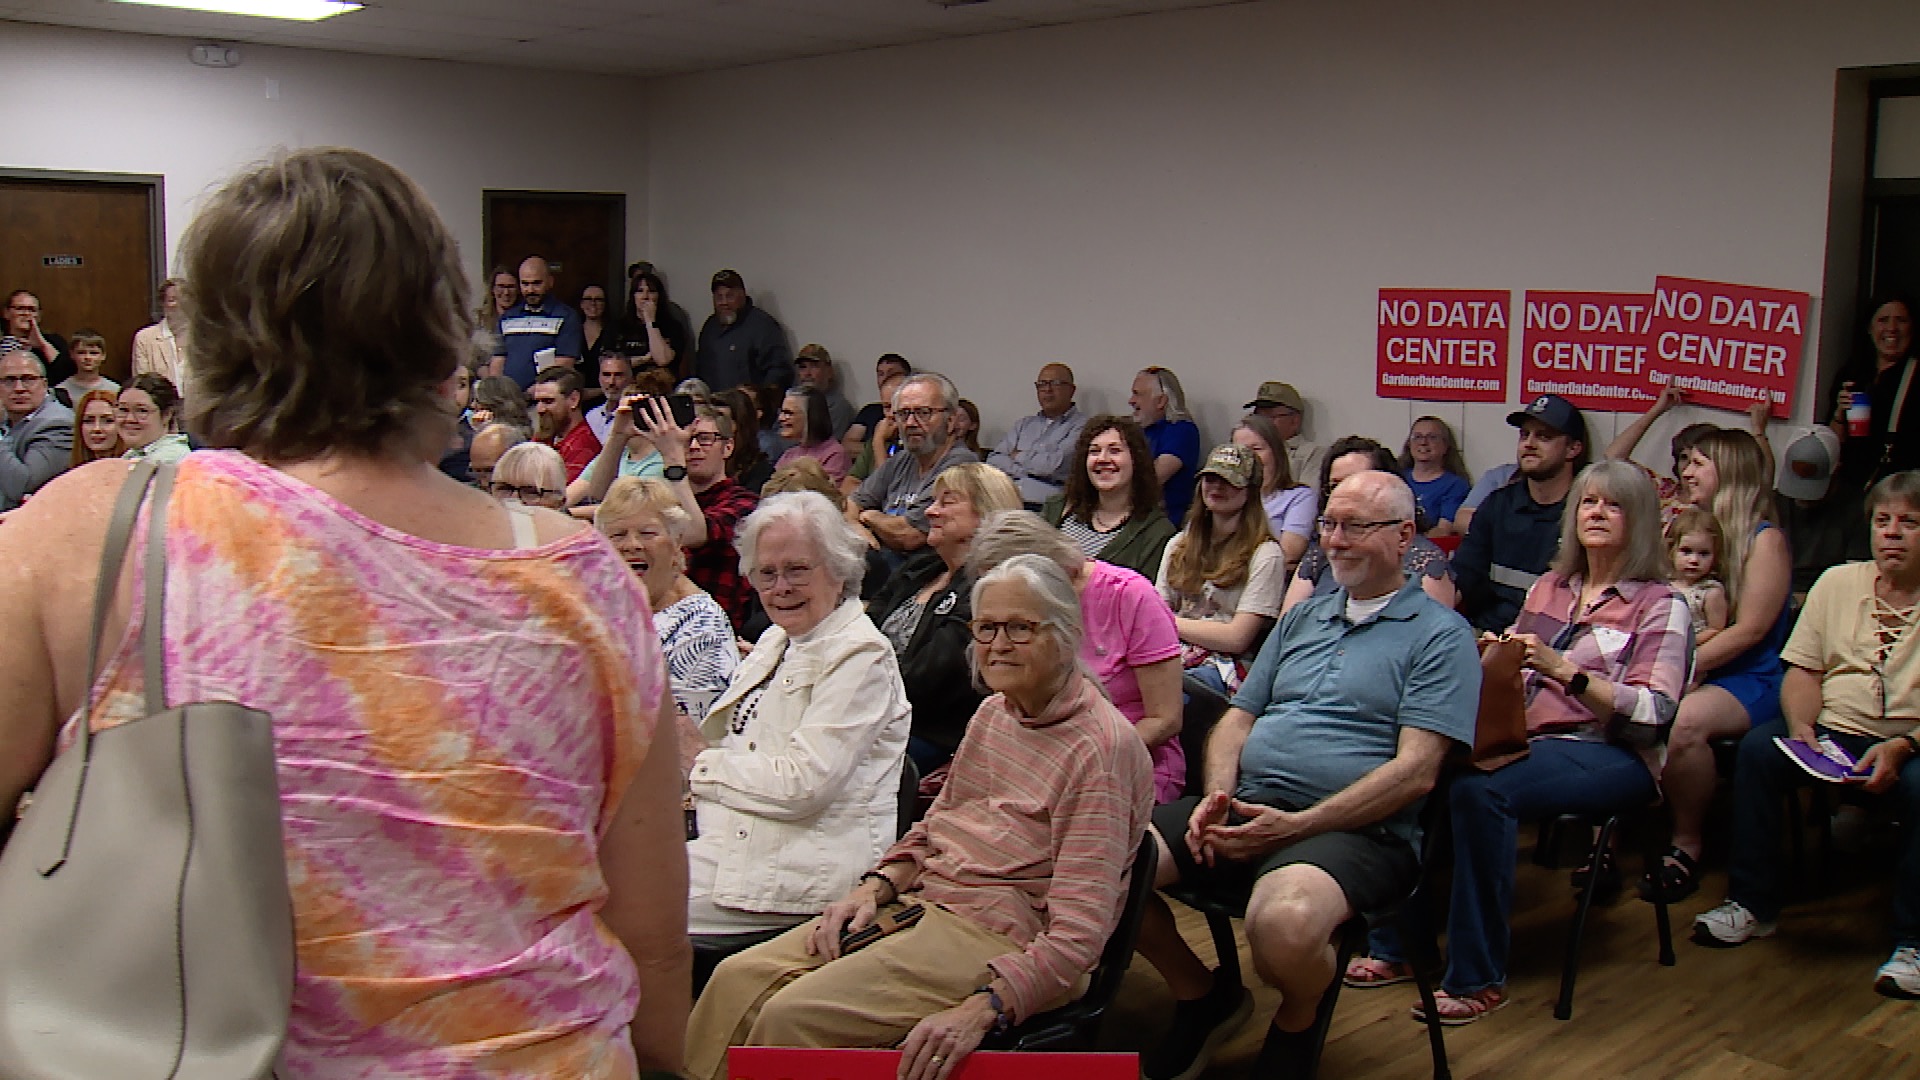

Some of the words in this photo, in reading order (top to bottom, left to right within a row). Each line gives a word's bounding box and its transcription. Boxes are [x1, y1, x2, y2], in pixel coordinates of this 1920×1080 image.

[1380, 300, 1421, 327] NO
[1427, 301, 1506, 329] DATA
[1526, 302, 1571, 331] NO
[1654, 288, 1702, 321] NO
[1709, 295, 1801, 335] DATA
[1386, 338, 1497, 367] CENTER
[1658, 332, 1787, 377] CENTER
[1382, 372, 1500, 390] GardnerDataCenter.com
[1527, 379, 1657, 400] GardnerDataCenter.c
[1649, 370, 1786, 405] GarnerDataCenter.cm
